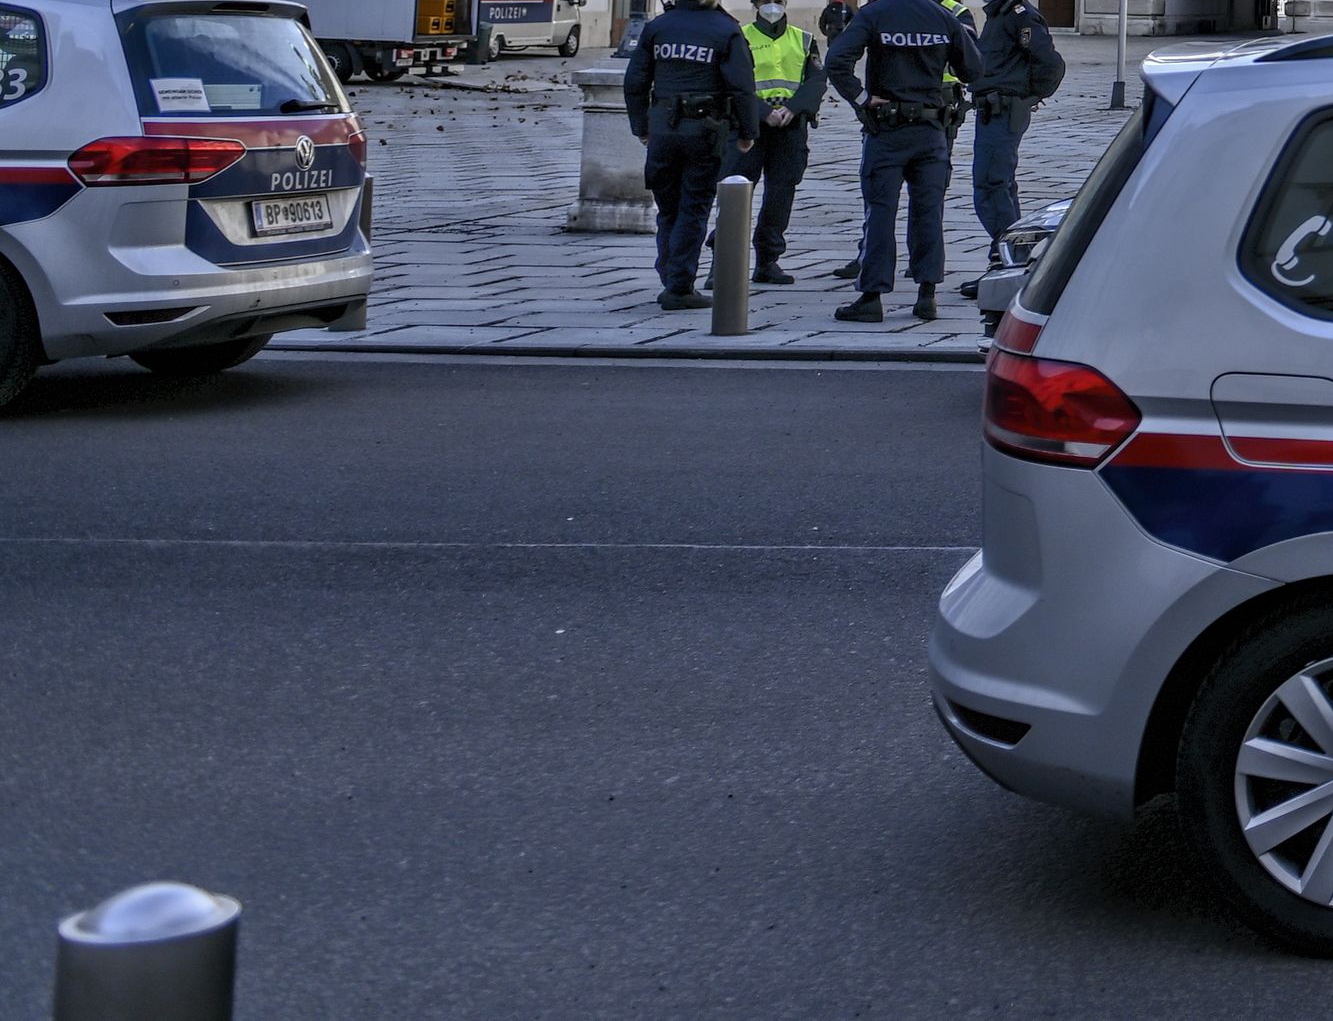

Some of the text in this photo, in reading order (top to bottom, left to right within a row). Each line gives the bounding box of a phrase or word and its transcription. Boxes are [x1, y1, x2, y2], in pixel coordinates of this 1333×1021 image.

[489, 7, 521, 19] POLIZEI
[653, 43, 714, 63] POLIZEI
[0, 67, 28, 100] 3
[271, 169, 333, 191] POLIZEI
[265, 200, 324, 225] BP 90613
